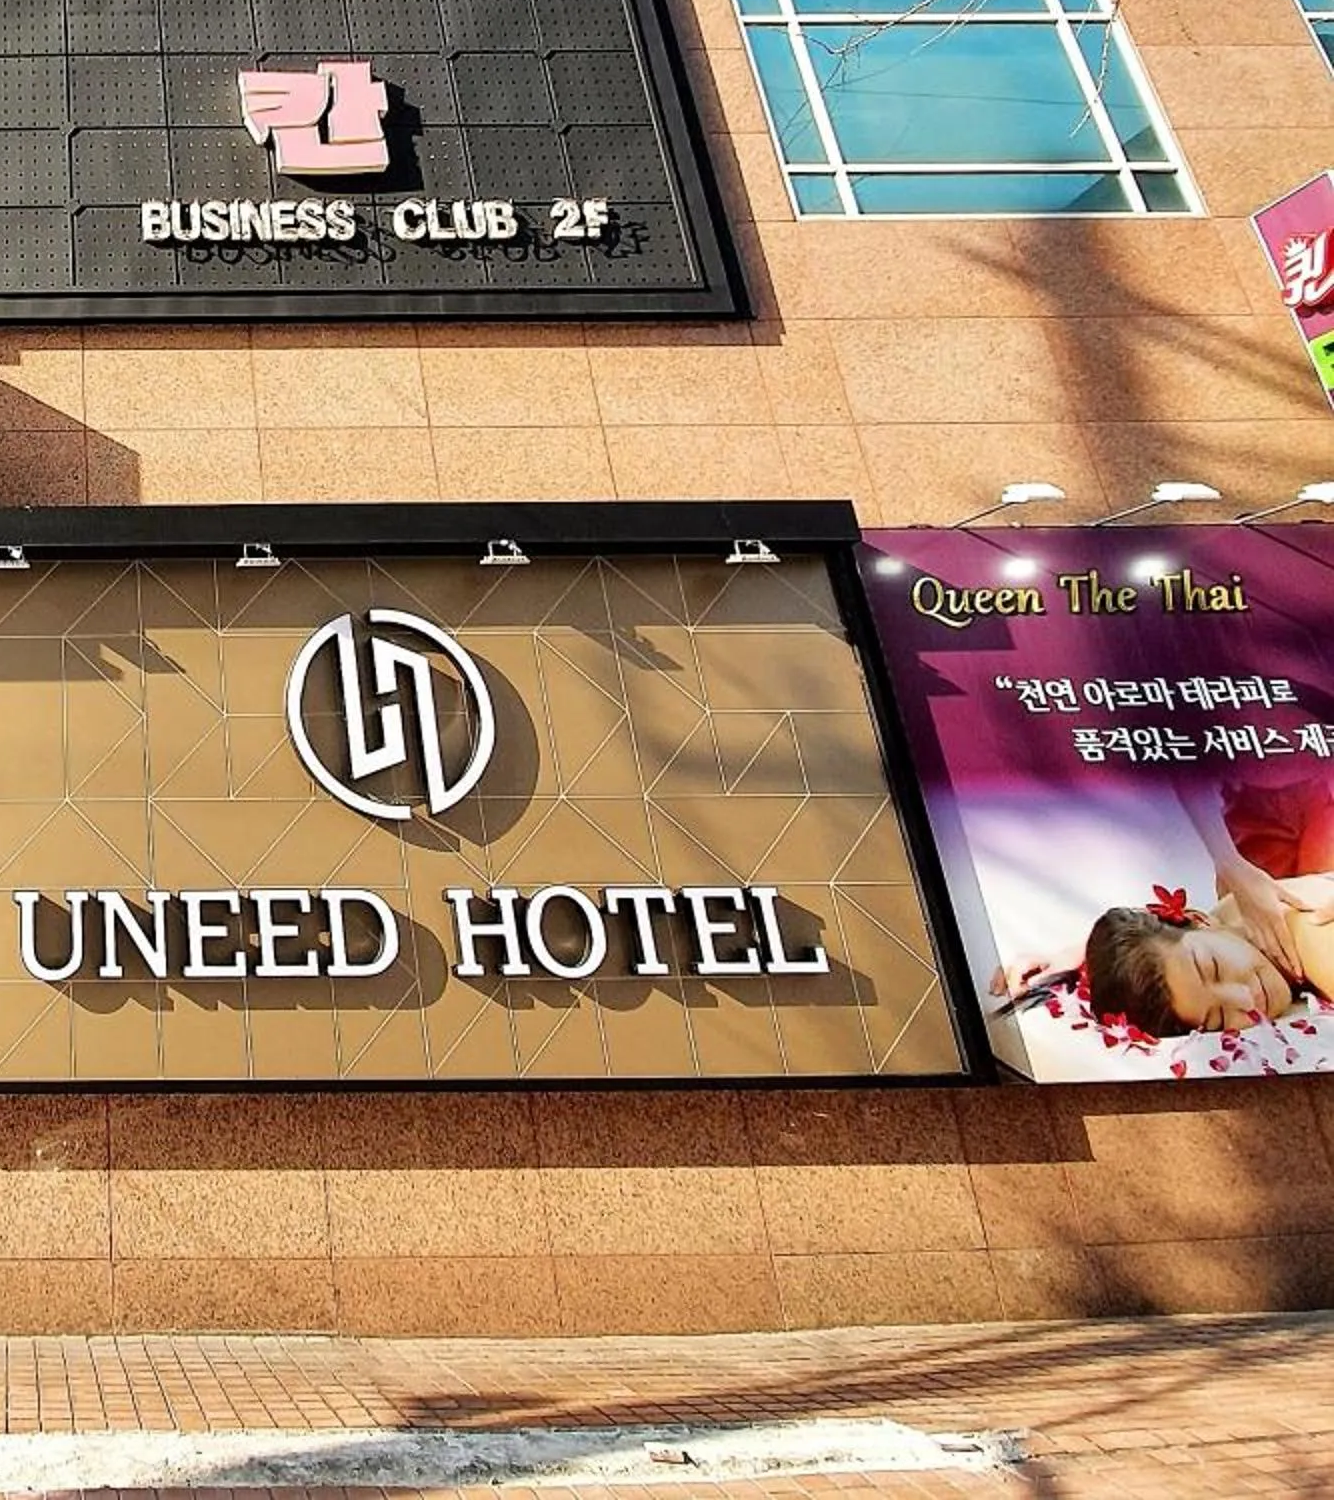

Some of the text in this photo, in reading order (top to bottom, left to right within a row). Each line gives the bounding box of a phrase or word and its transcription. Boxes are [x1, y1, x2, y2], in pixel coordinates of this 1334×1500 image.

[140, 200, 610, 244] BUSINESS CLUB 2F
[911, 569, 1249, 629] Queen The Thai
[1083, 677, 1174, 711] 아로마
[1176, 676, 1298, 710] 테라피로
[1072, 726, 1198, 762] 품격있는
[1204, 725, 1295, 760] 서비스
[14, 884, 831, 982] UNEED HOTEL
